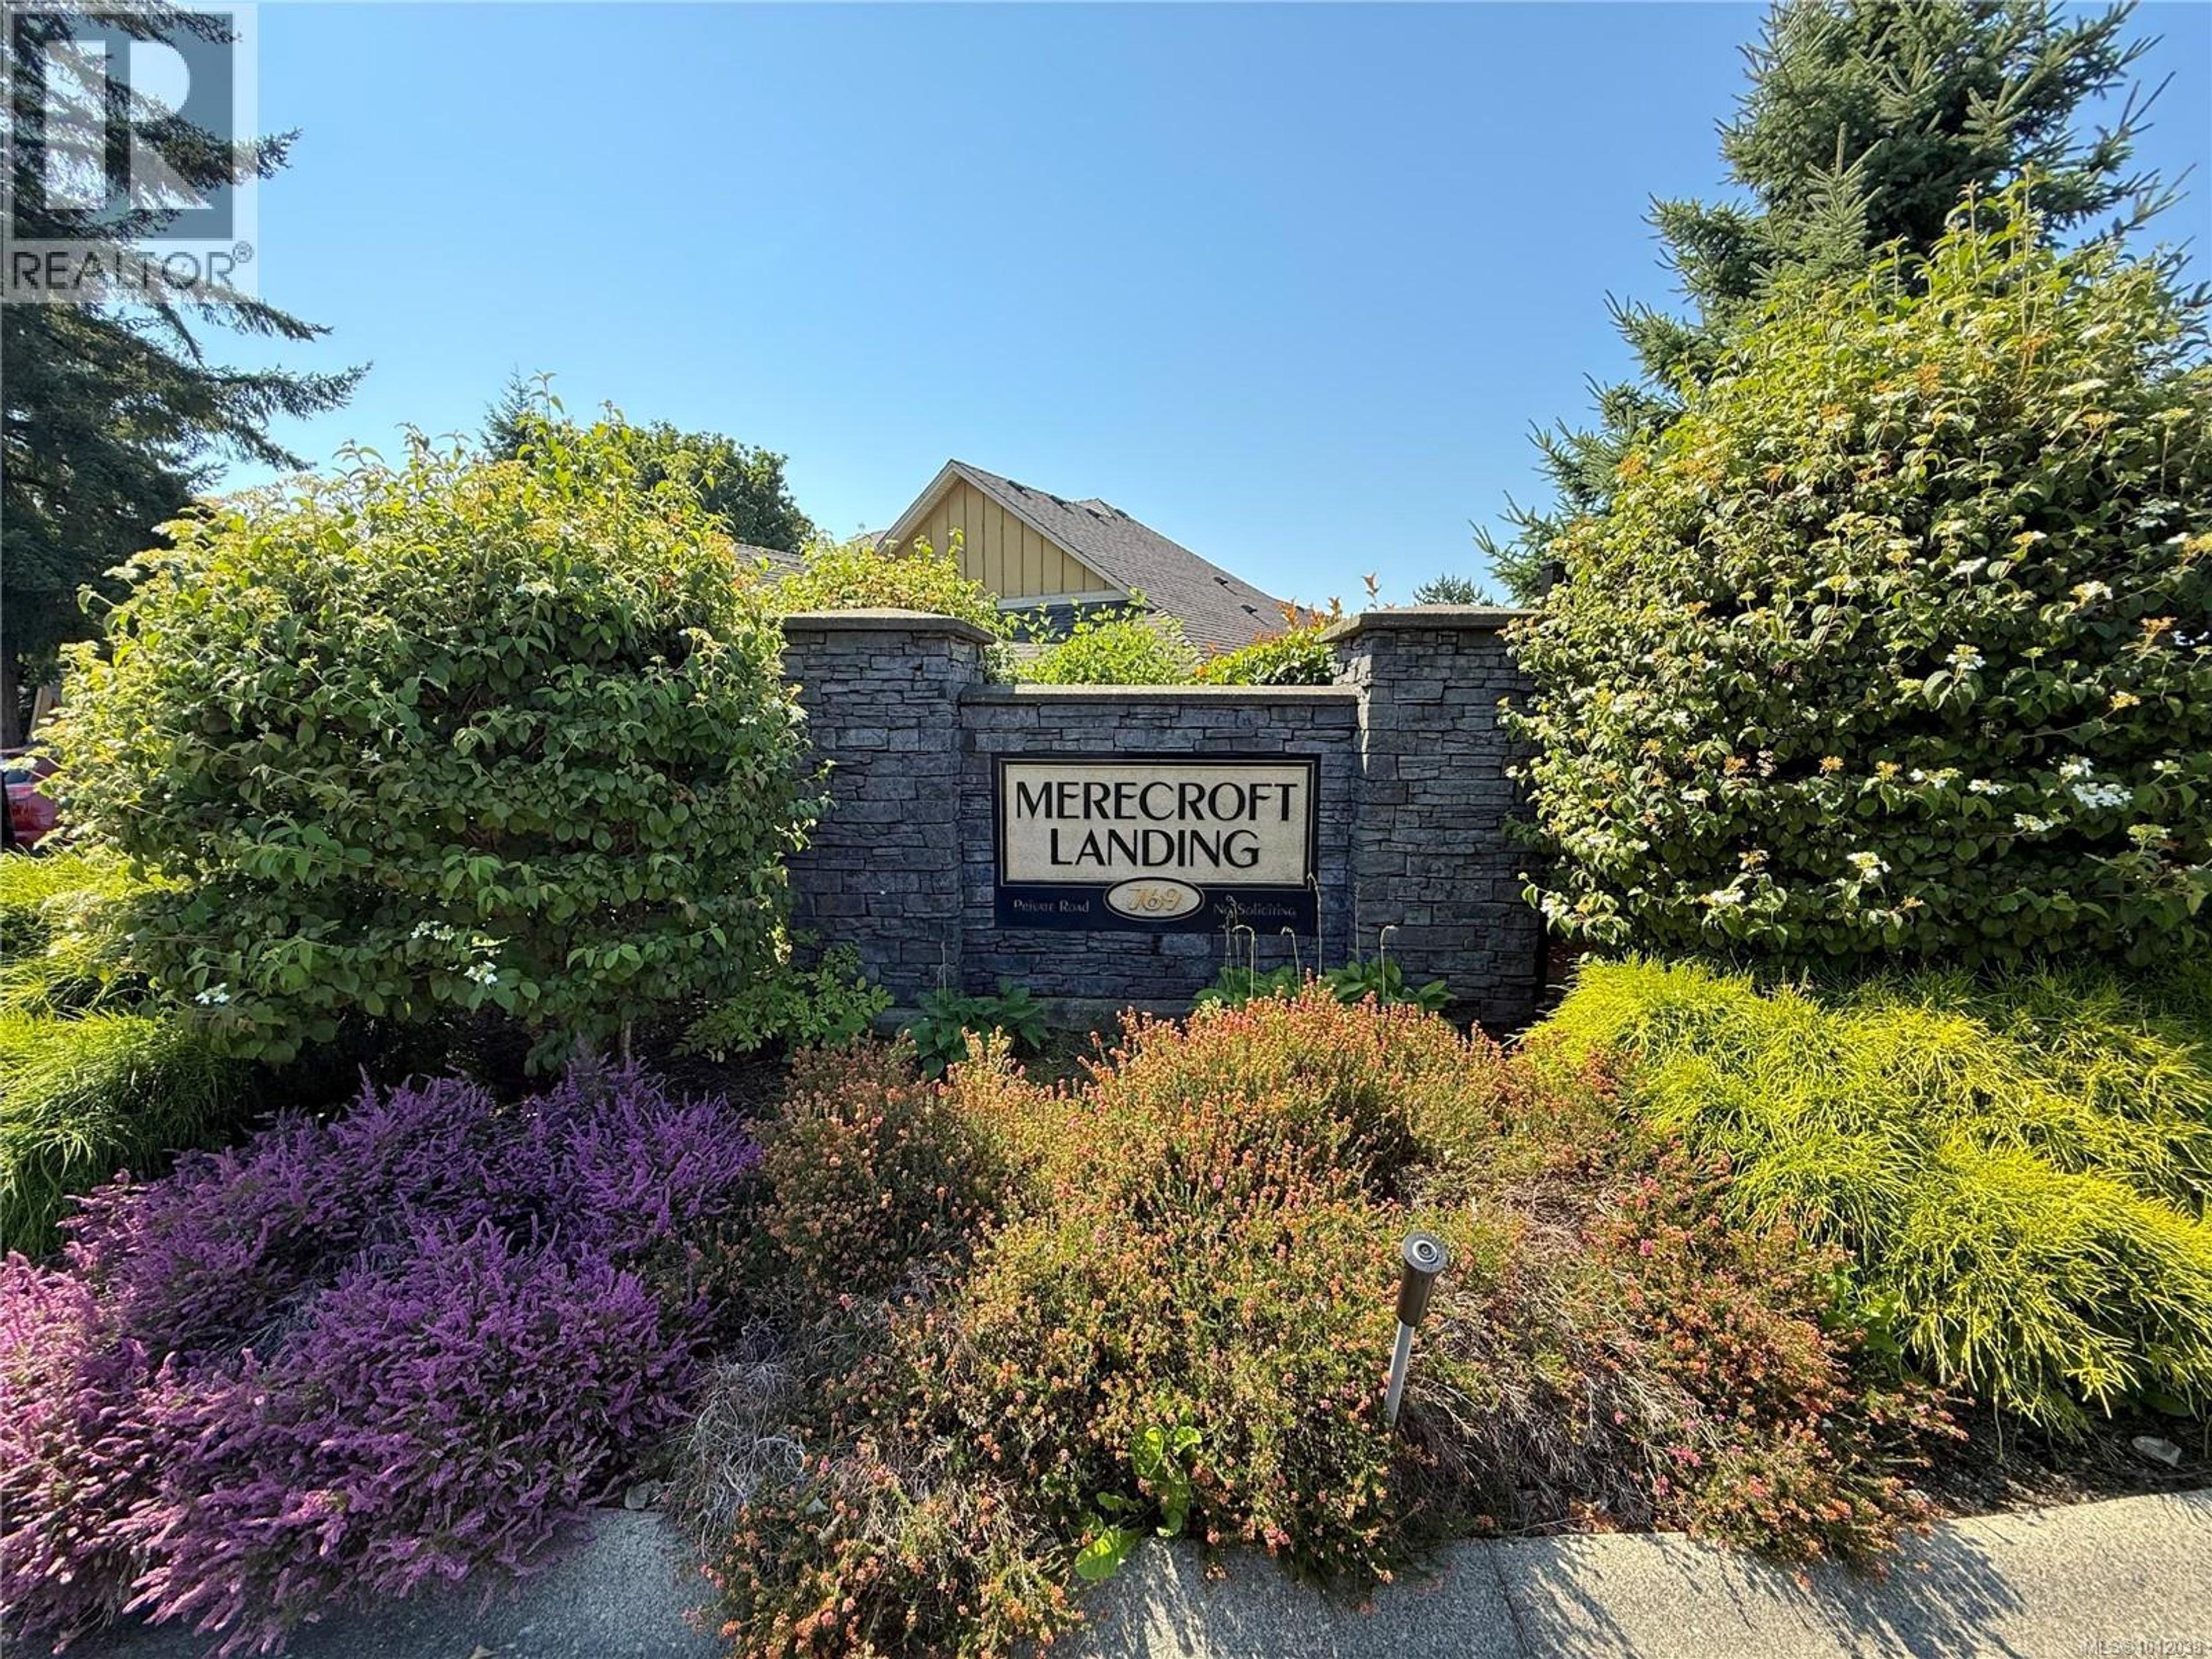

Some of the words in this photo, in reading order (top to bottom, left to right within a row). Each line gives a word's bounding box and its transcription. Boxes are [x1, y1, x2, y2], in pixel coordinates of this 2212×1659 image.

[1016, 781, 1298, 821] MERECROFT
[1050, 828, 1260, 869] LANDING
[1127, 888, 1183, 911] 769
